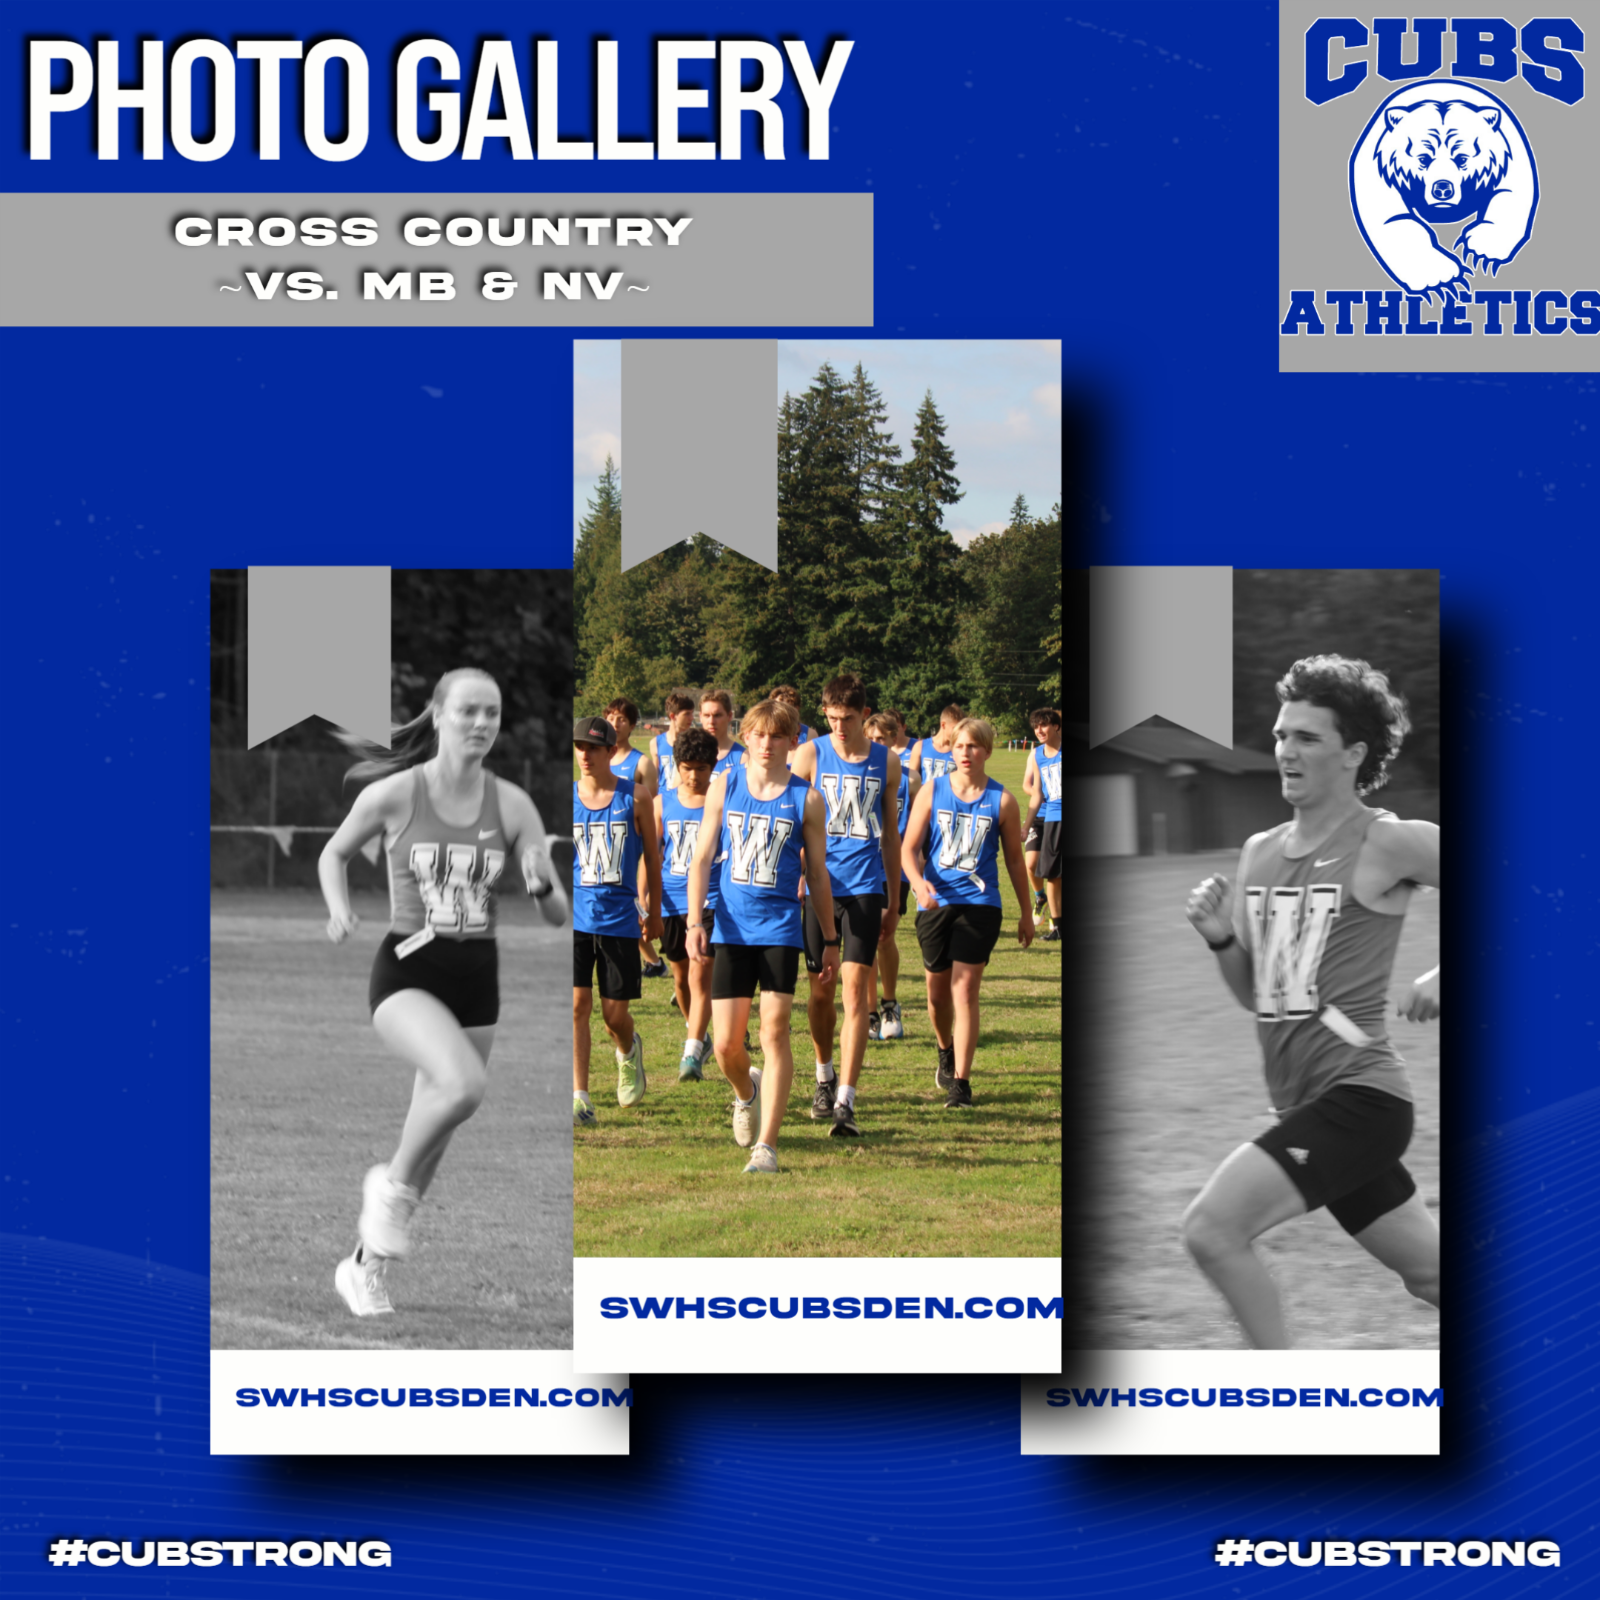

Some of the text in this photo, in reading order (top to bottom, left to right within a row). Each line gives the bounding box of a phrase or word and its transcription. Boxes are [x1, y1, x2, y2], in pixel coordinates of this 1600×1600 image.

[821, 773, 881, 840] W
[937, 810, 992, 873] W
[573, 822, 627, 886] W
[727, 811, 794, 888] W
[409, 842, 505, 933] W
[1246, 884, 1342, 1022] W
